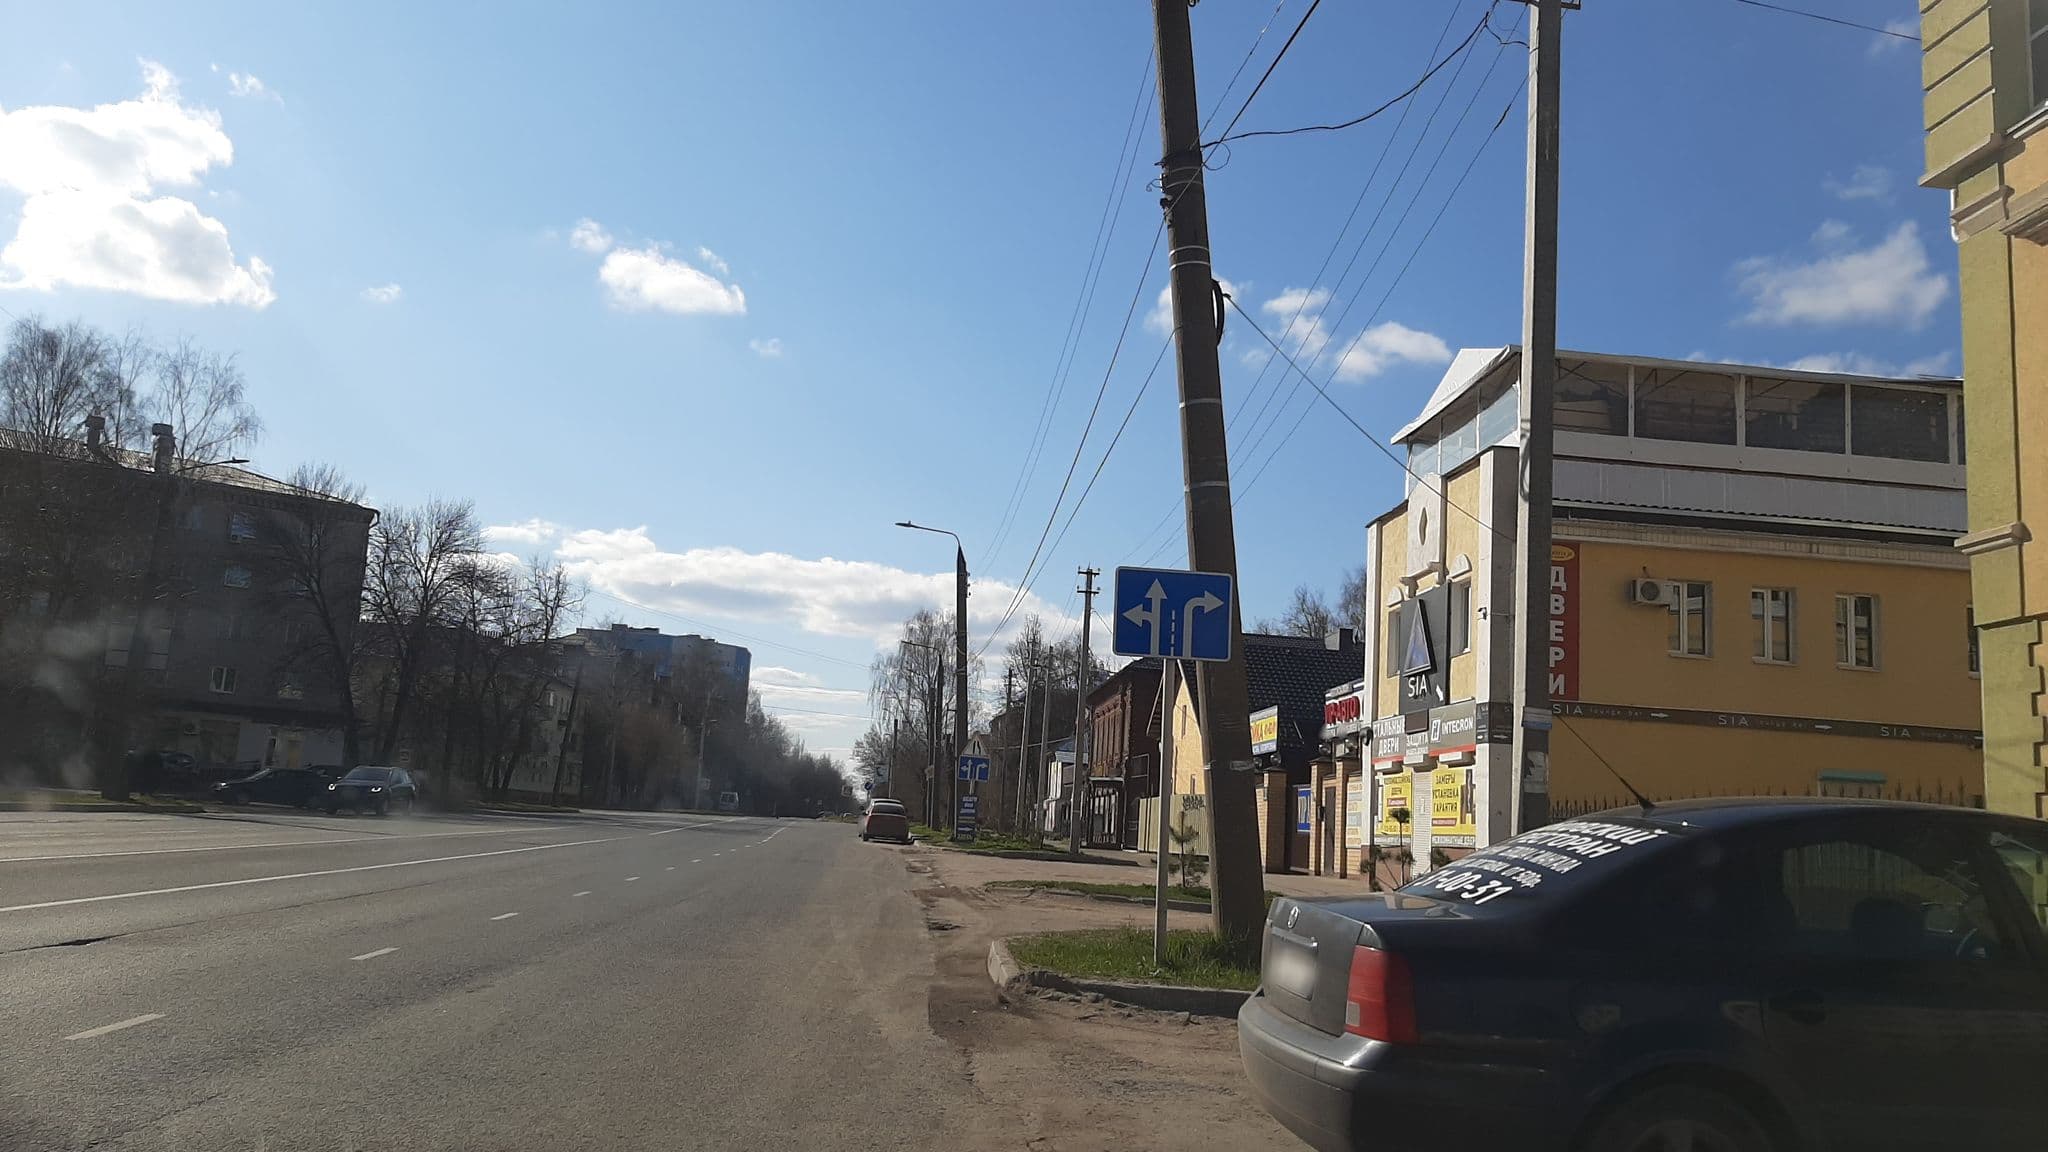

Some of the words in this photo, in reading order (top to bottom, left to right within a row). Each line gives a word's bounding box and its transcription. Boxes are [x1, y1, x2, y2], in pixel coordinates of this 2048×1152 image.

[1549, 566, 1567, 695] ДВЕРИ
[1408, 674, 1427, 697] SIA
[1552, 703, 1582, 714] SIA
[1442, 716, 1473, 735] INTECRON
[1718, 716, 1748, 727] SIA
[1880, 727, 1911, 738] SIA
[1379, 736, 1399, 756] ДВЕРИ
